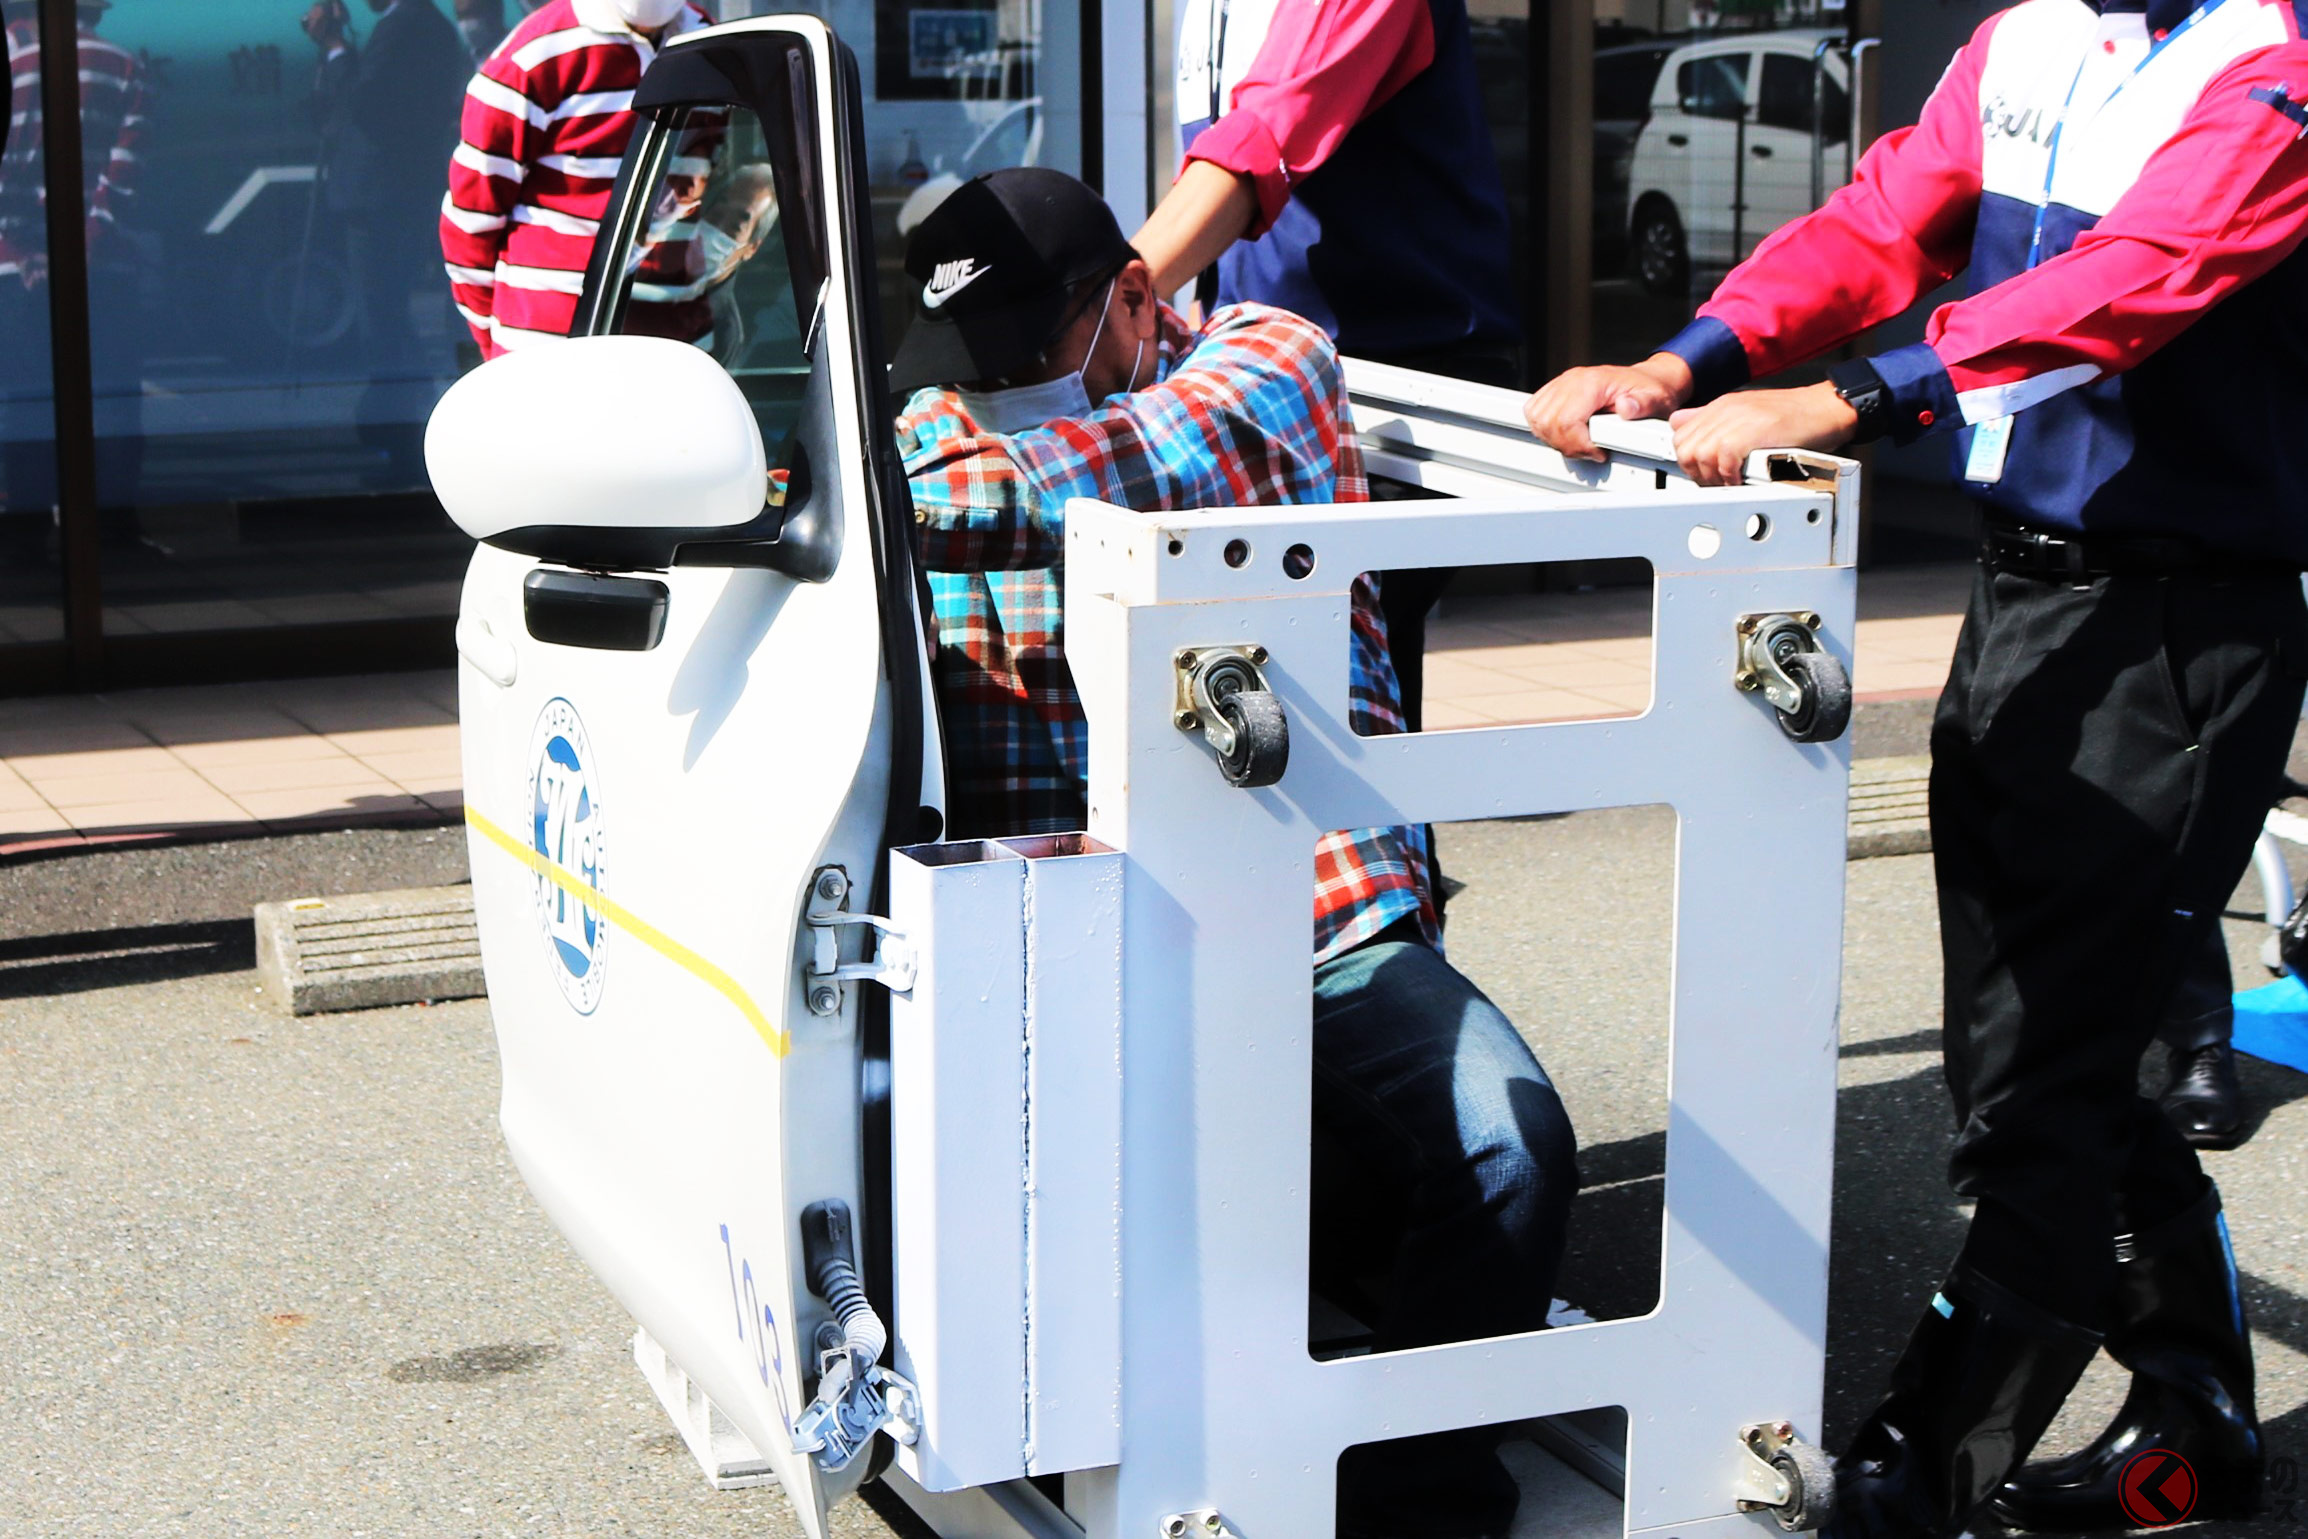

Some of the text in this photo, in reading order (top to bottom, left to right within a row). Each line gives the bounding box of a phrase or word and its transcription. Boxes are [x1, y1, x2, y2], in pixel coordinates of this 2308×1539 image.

[930, 257, 975, 291] NIKE
[544, 706, 585, 757] JAPAN
[580, 802, 606, 1006] AUTOMOBILE
[719, 1222, 792, 1437] 103
